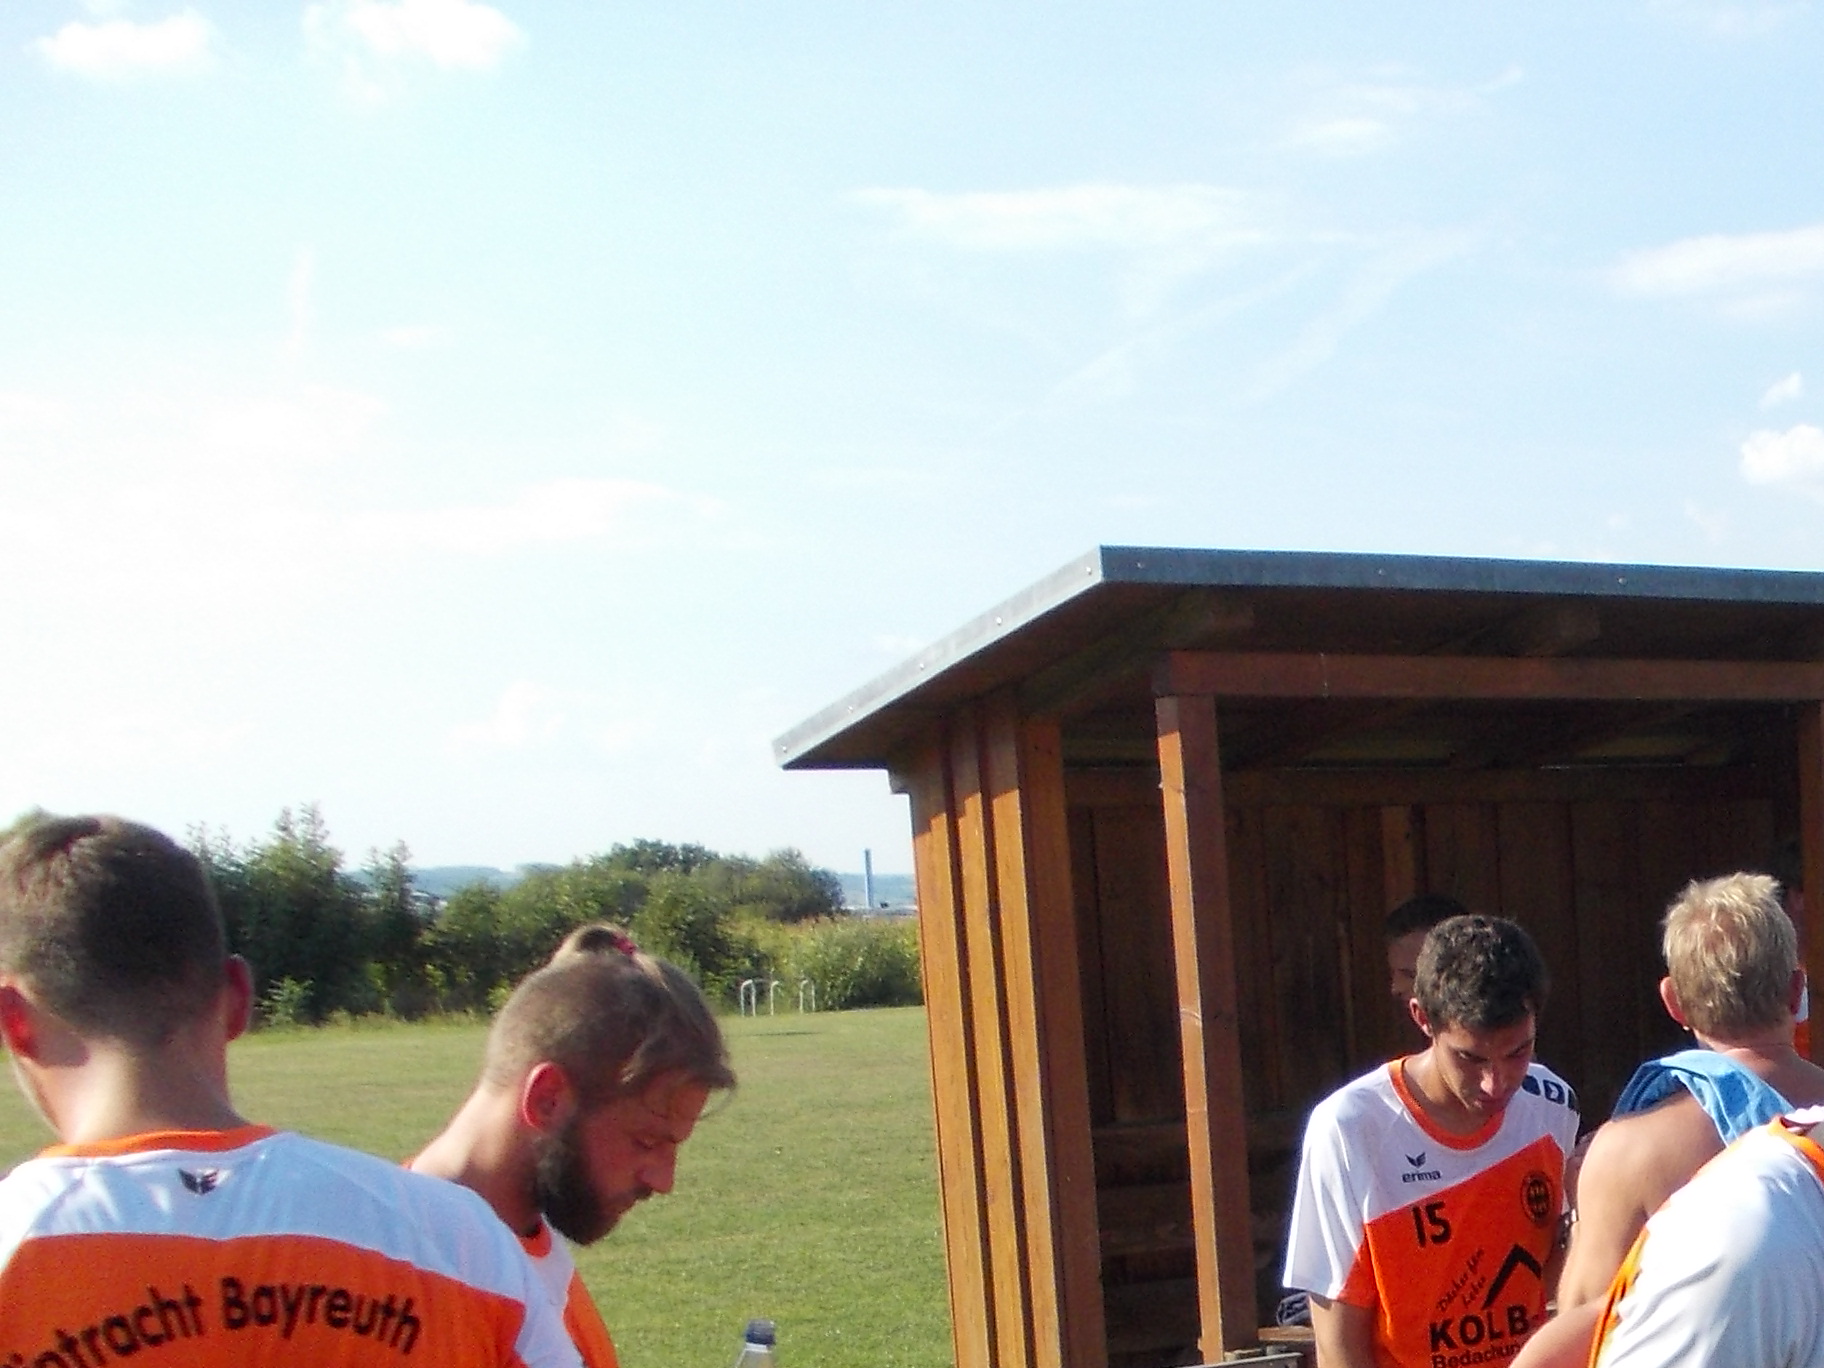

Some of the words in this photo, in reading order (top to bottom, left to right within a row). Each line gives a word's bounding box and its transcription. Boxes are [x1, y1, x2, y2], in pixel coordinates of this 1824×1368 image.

[1413, 1201, 1451, 1248] 15
[219, 1276, 421, 1355] Bayreuth
[1429, 1305, 1529, 1353] KOLB
